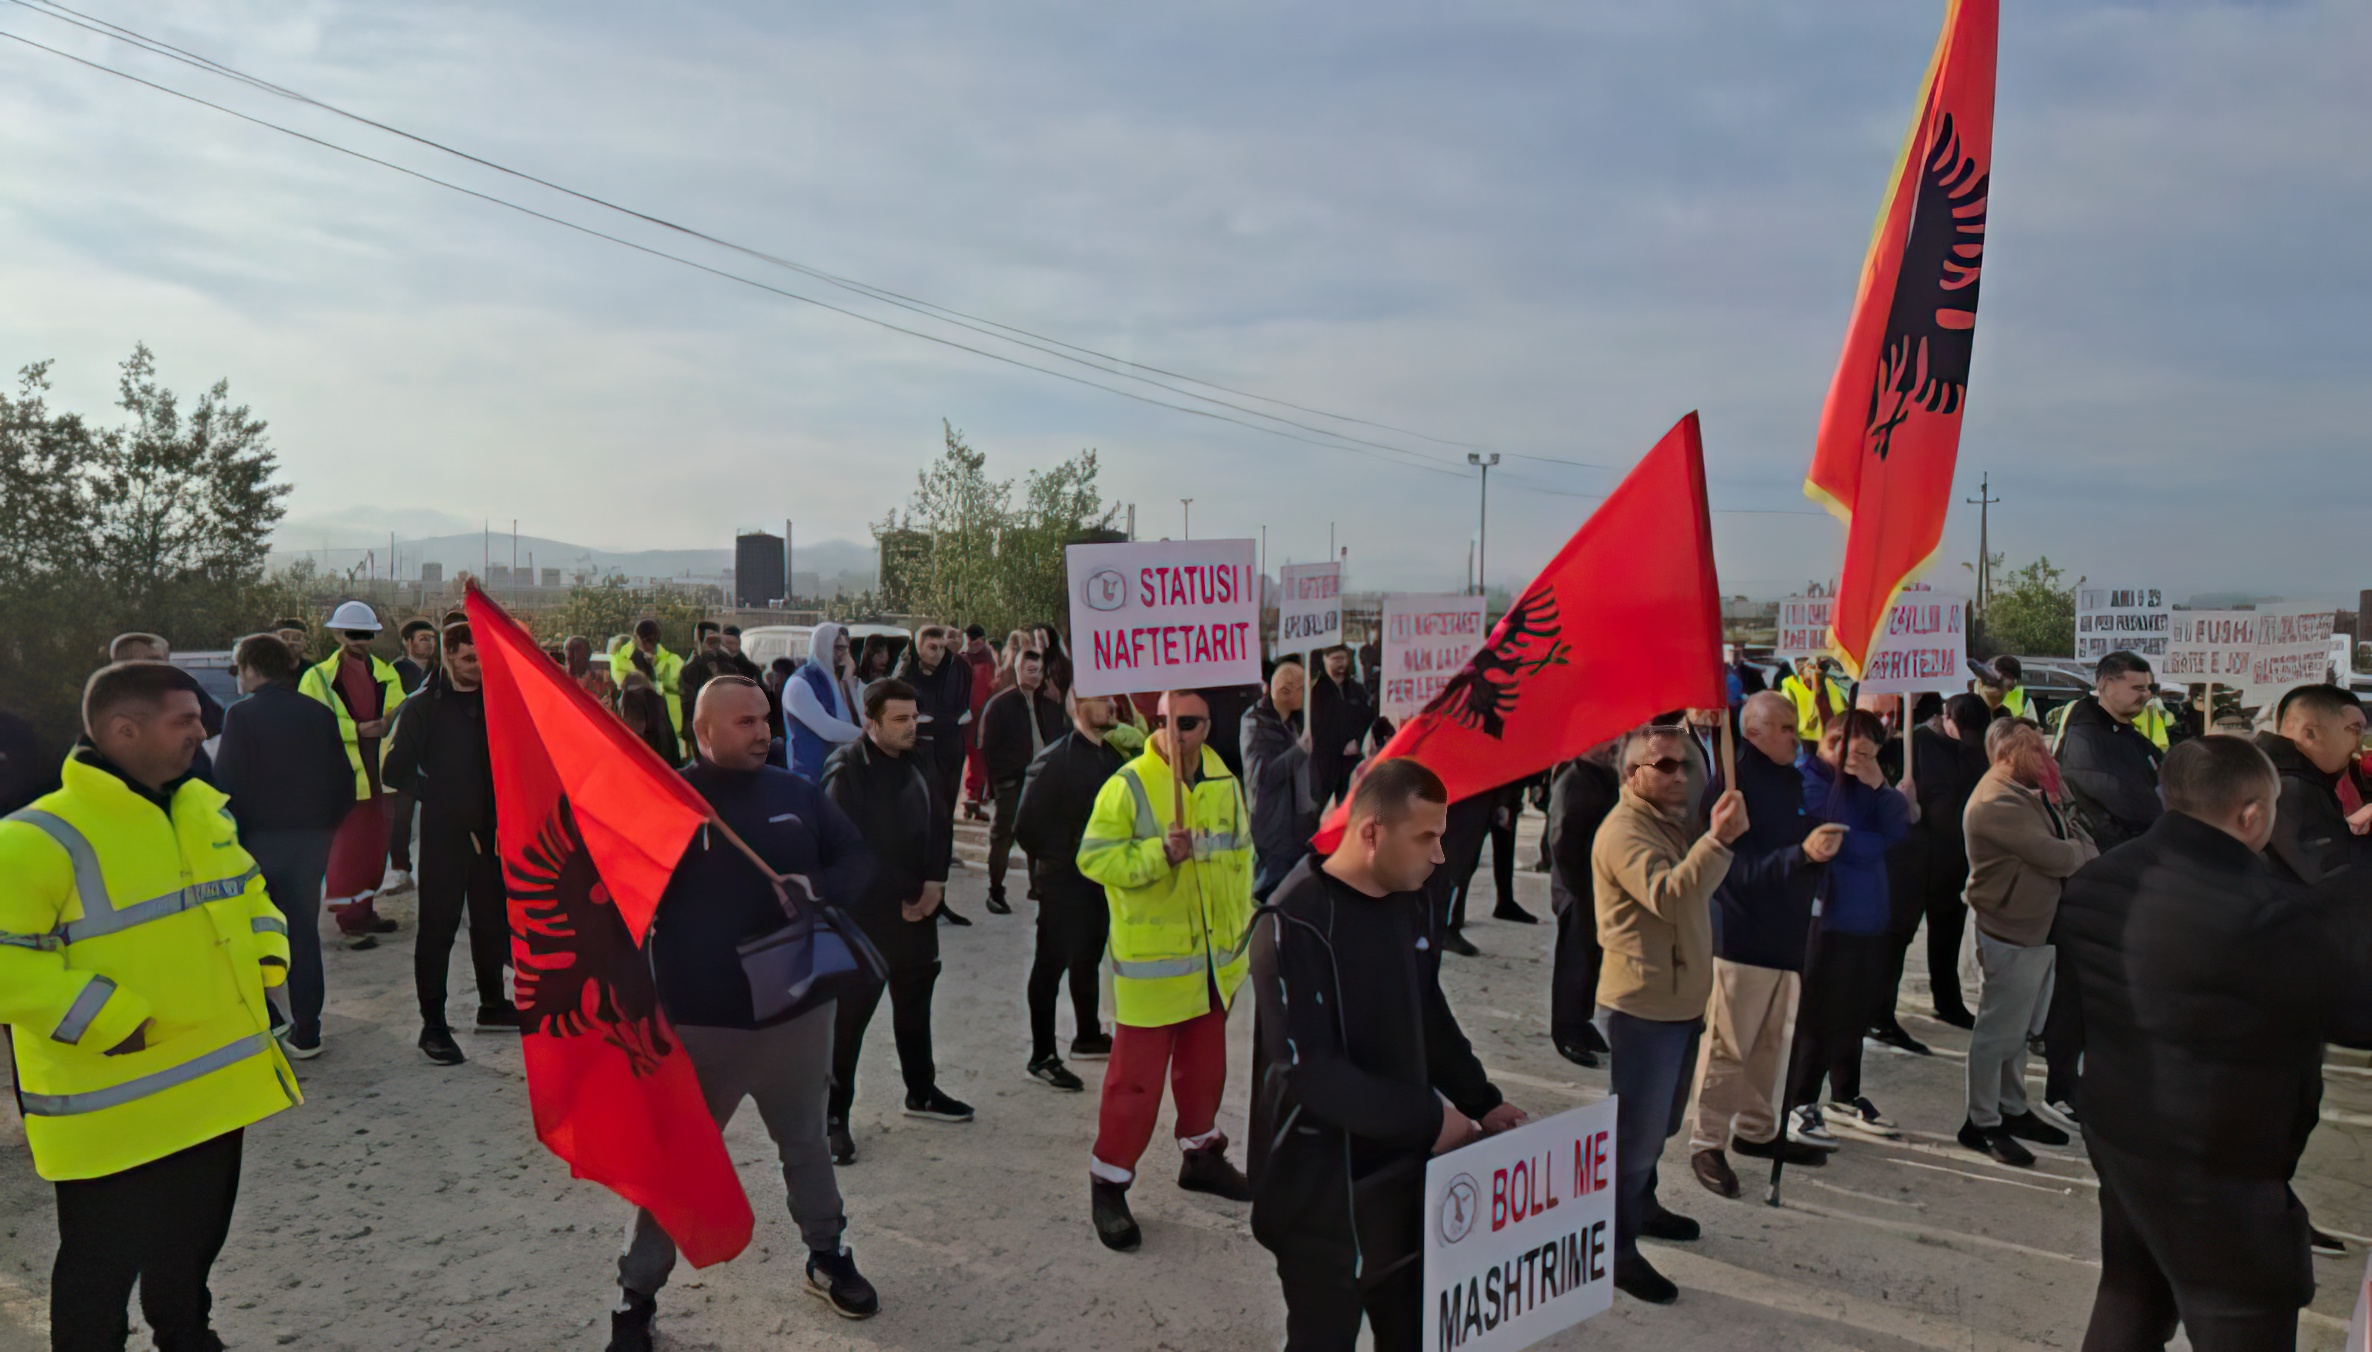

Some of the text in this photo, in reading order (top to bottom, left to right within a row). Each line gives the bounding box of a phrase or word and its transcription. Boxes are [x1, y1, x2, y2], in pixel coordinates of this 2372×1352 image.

[1140, 564, 1238, 608] STATUSI
[1246, 564, 1252, 603] I
[1093, 622, 1249, 671] NAFTETARIT
[1491, 1130, 1609, 1233] BOLL ME
[1439, 1219, 1606, 1352] MASHTRIME
